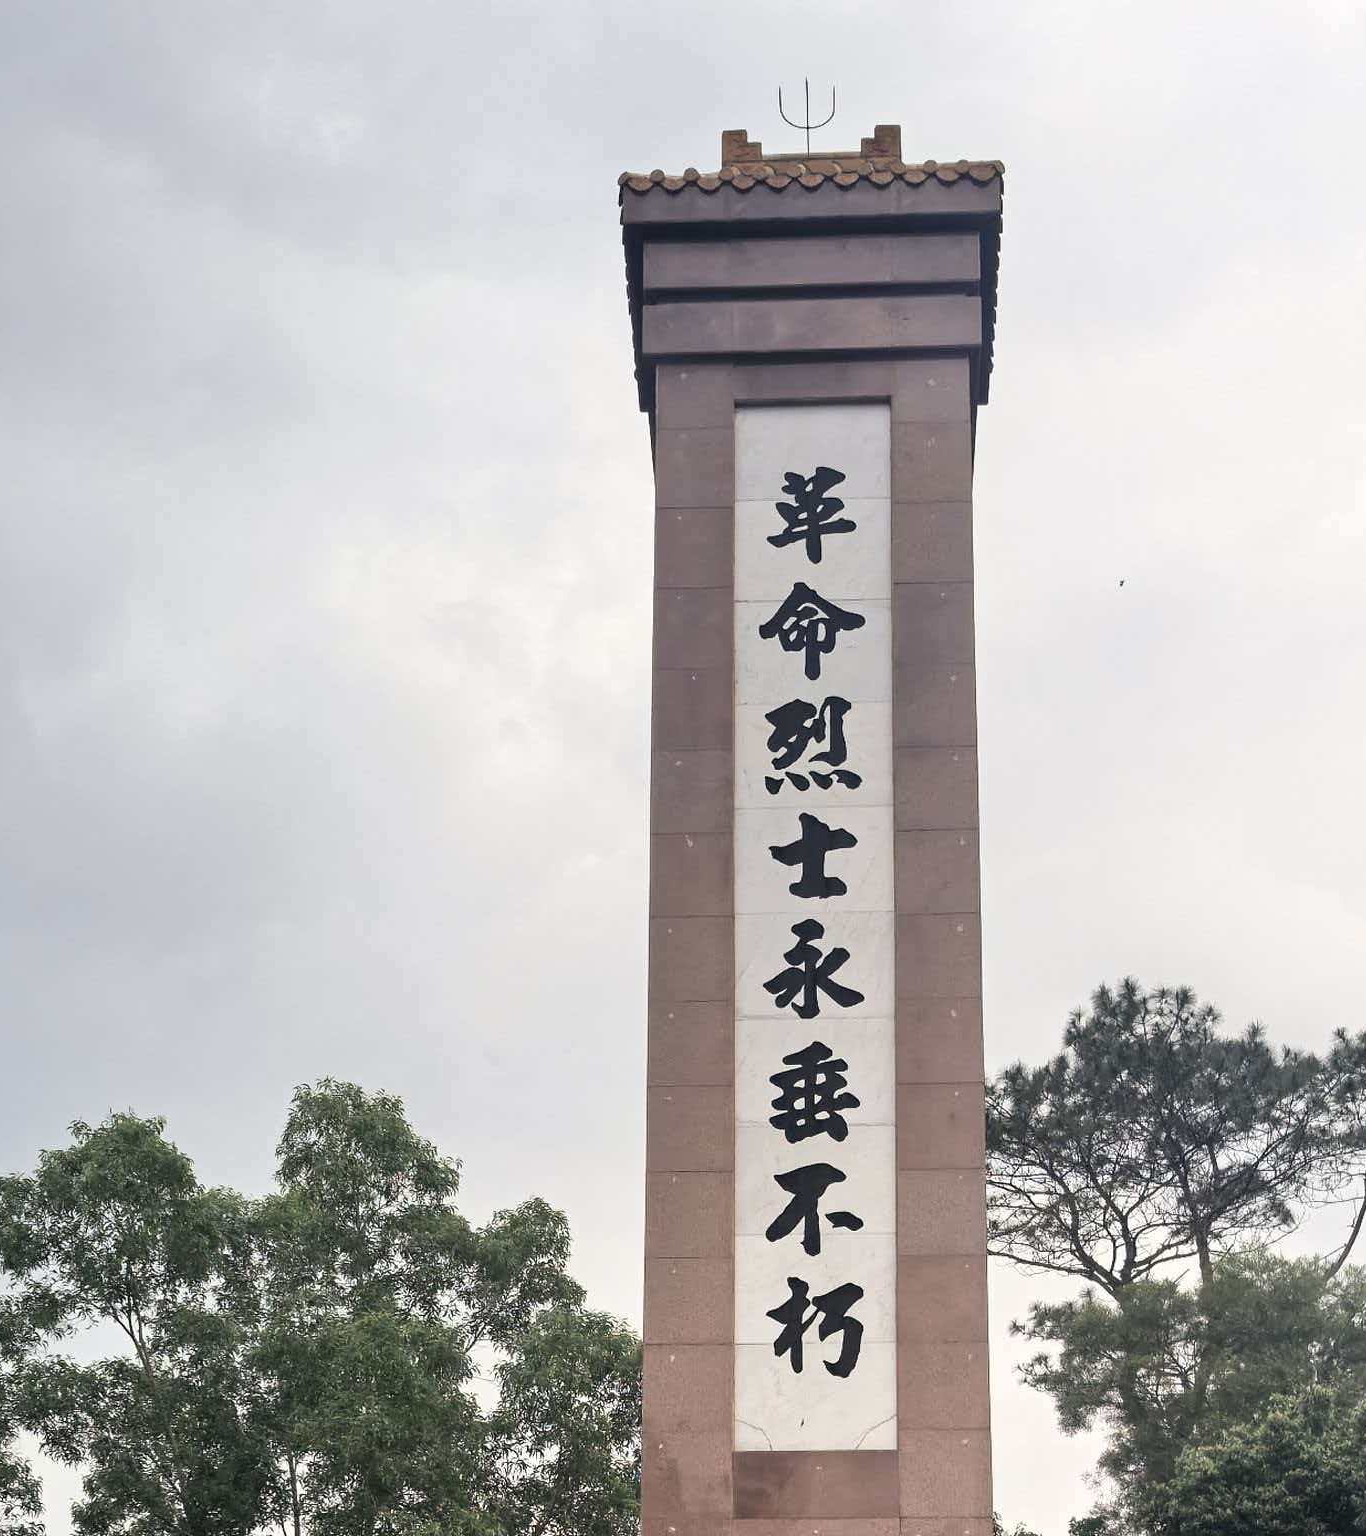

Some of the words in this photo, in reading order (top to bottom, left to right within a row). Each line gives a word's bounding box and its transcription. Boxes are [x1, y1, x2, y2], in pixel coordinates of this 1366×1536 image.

[759, 465, 865, 1377] 革命烈士永垂不朽
